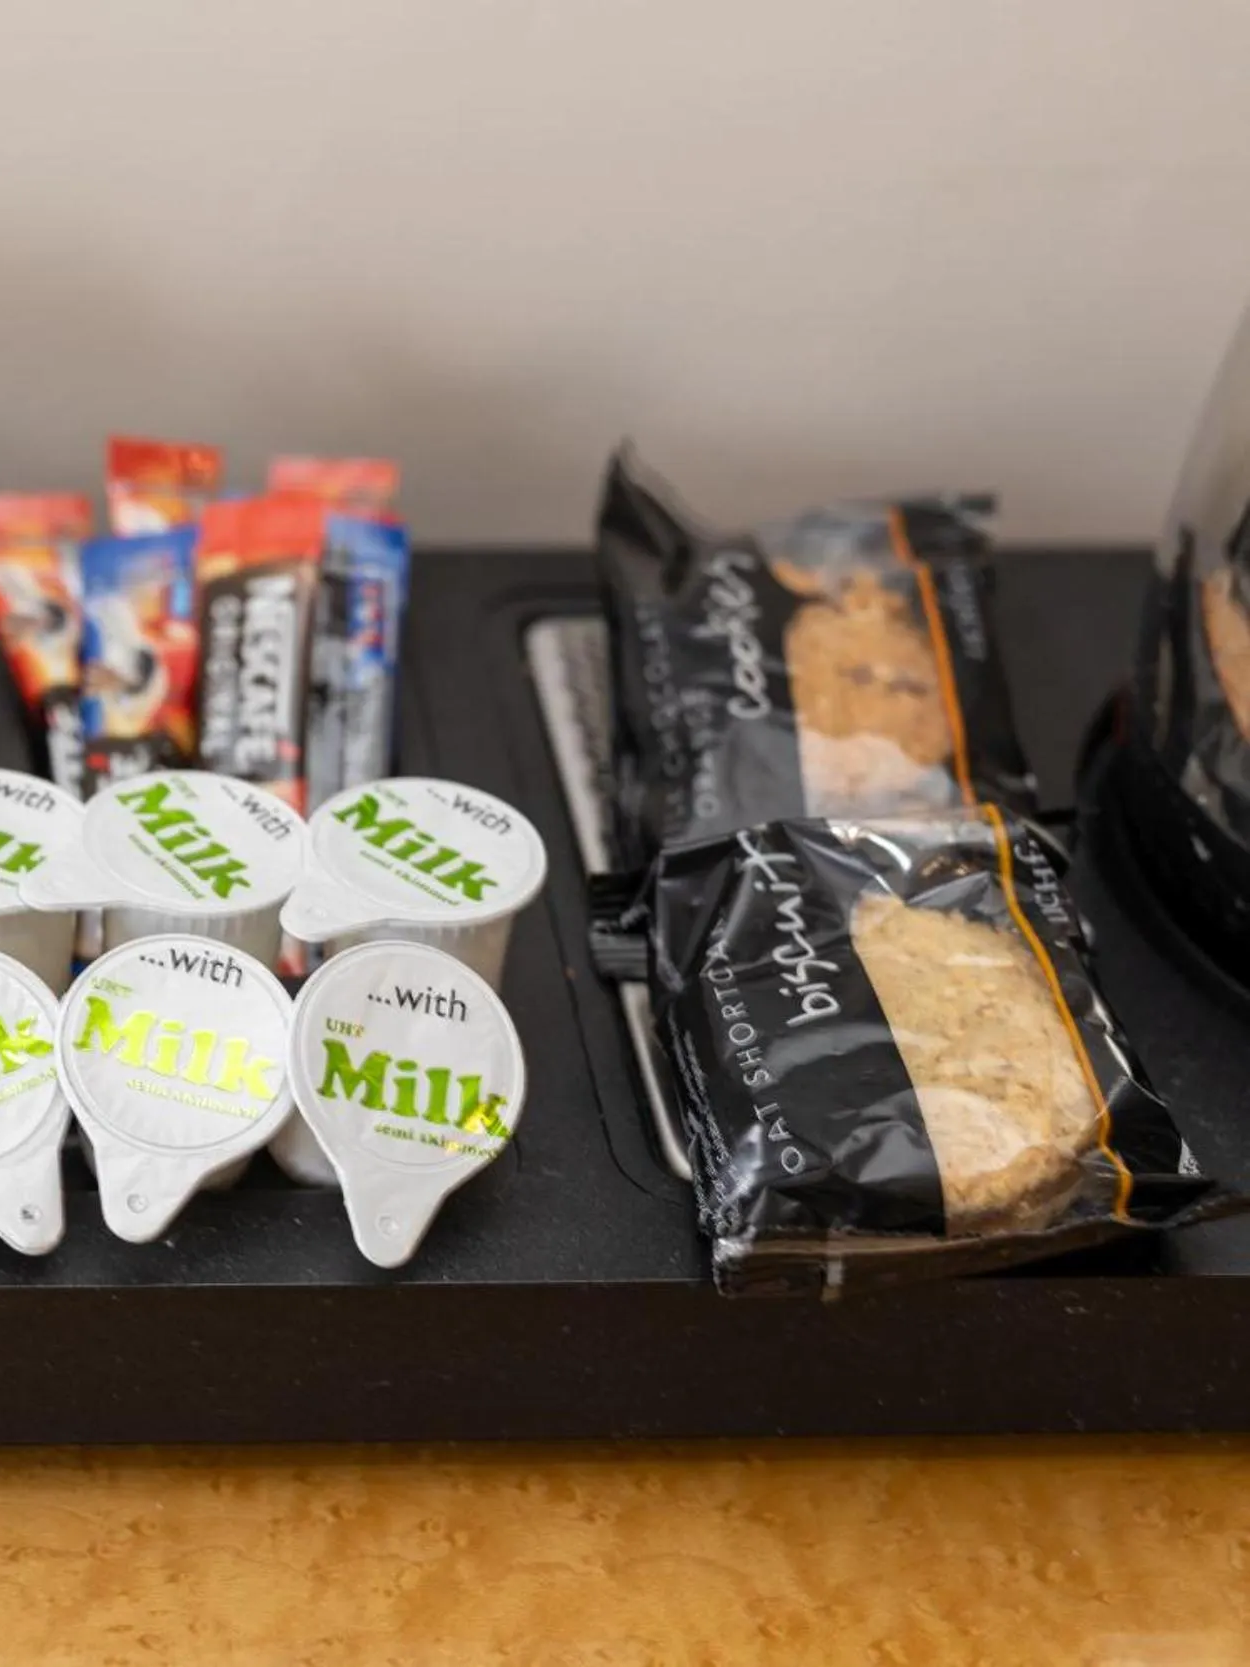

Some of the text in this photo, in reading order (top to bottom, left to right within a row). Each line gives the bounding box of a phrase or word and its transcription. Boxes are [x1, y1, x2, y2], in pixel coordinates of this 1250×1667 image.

[115, 781, 252, 900] Milk
[330, 792, 500, 903] Milk
[138, 947, 243, 988] ...with
[736, 829, 841, 1028] biscuit
[72, 995, 279, 1103] Milk
[367, 985, 468, 1023] ...with
[316, 1038, 511, 1140] Milk
[753, 1102, 806, 1175] OAT
